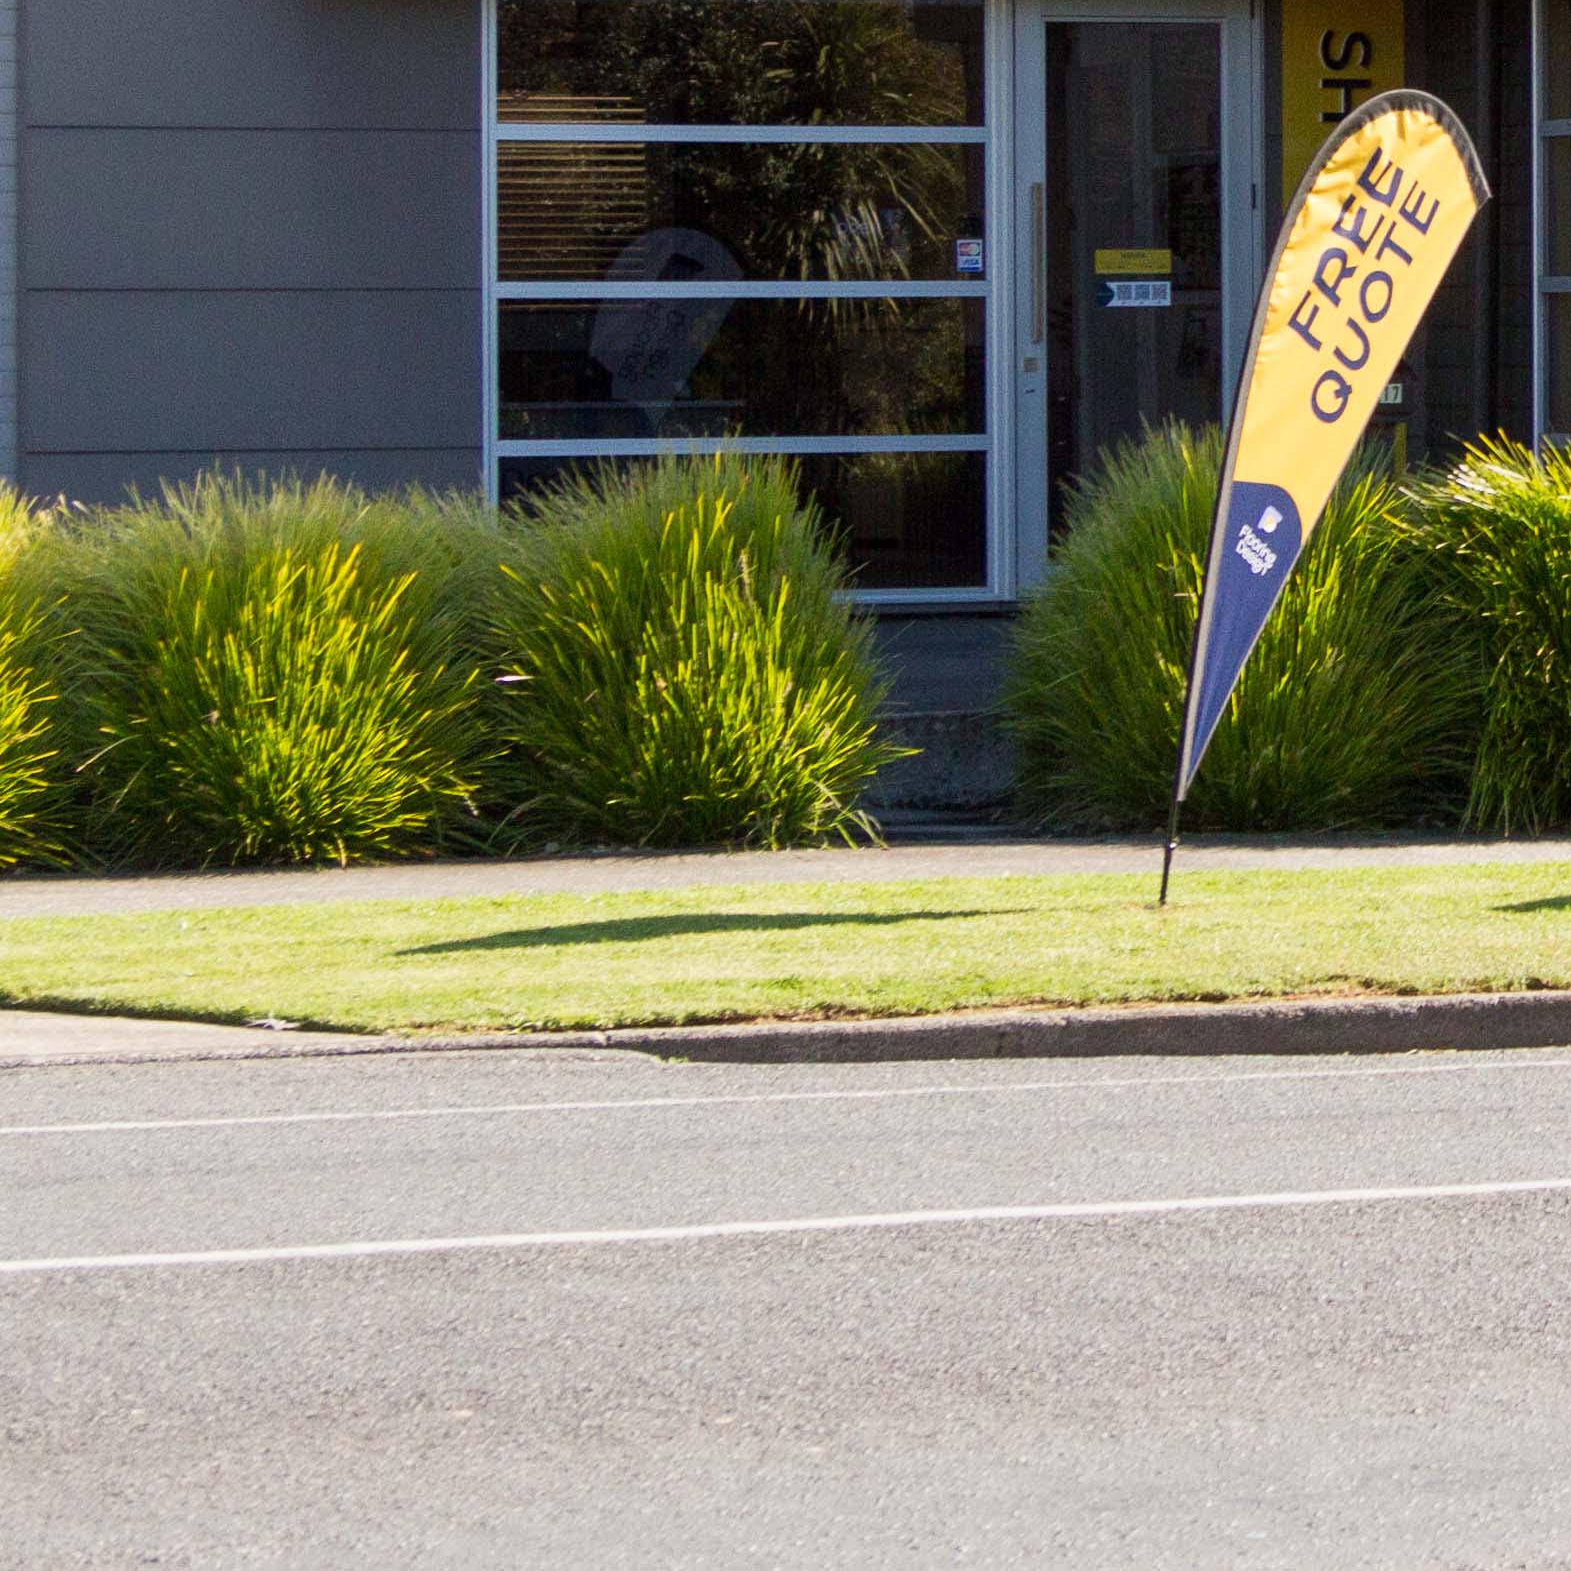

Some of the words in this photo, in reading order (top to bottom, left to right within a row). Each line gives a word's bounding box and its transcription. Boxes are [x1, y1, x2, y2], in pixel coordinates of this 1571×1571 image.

[1288, 147, 1404, 351] FREE
[1310, 179, 1441, 424] QUOTE
[1238, 524, 1278, 569] Flooring
